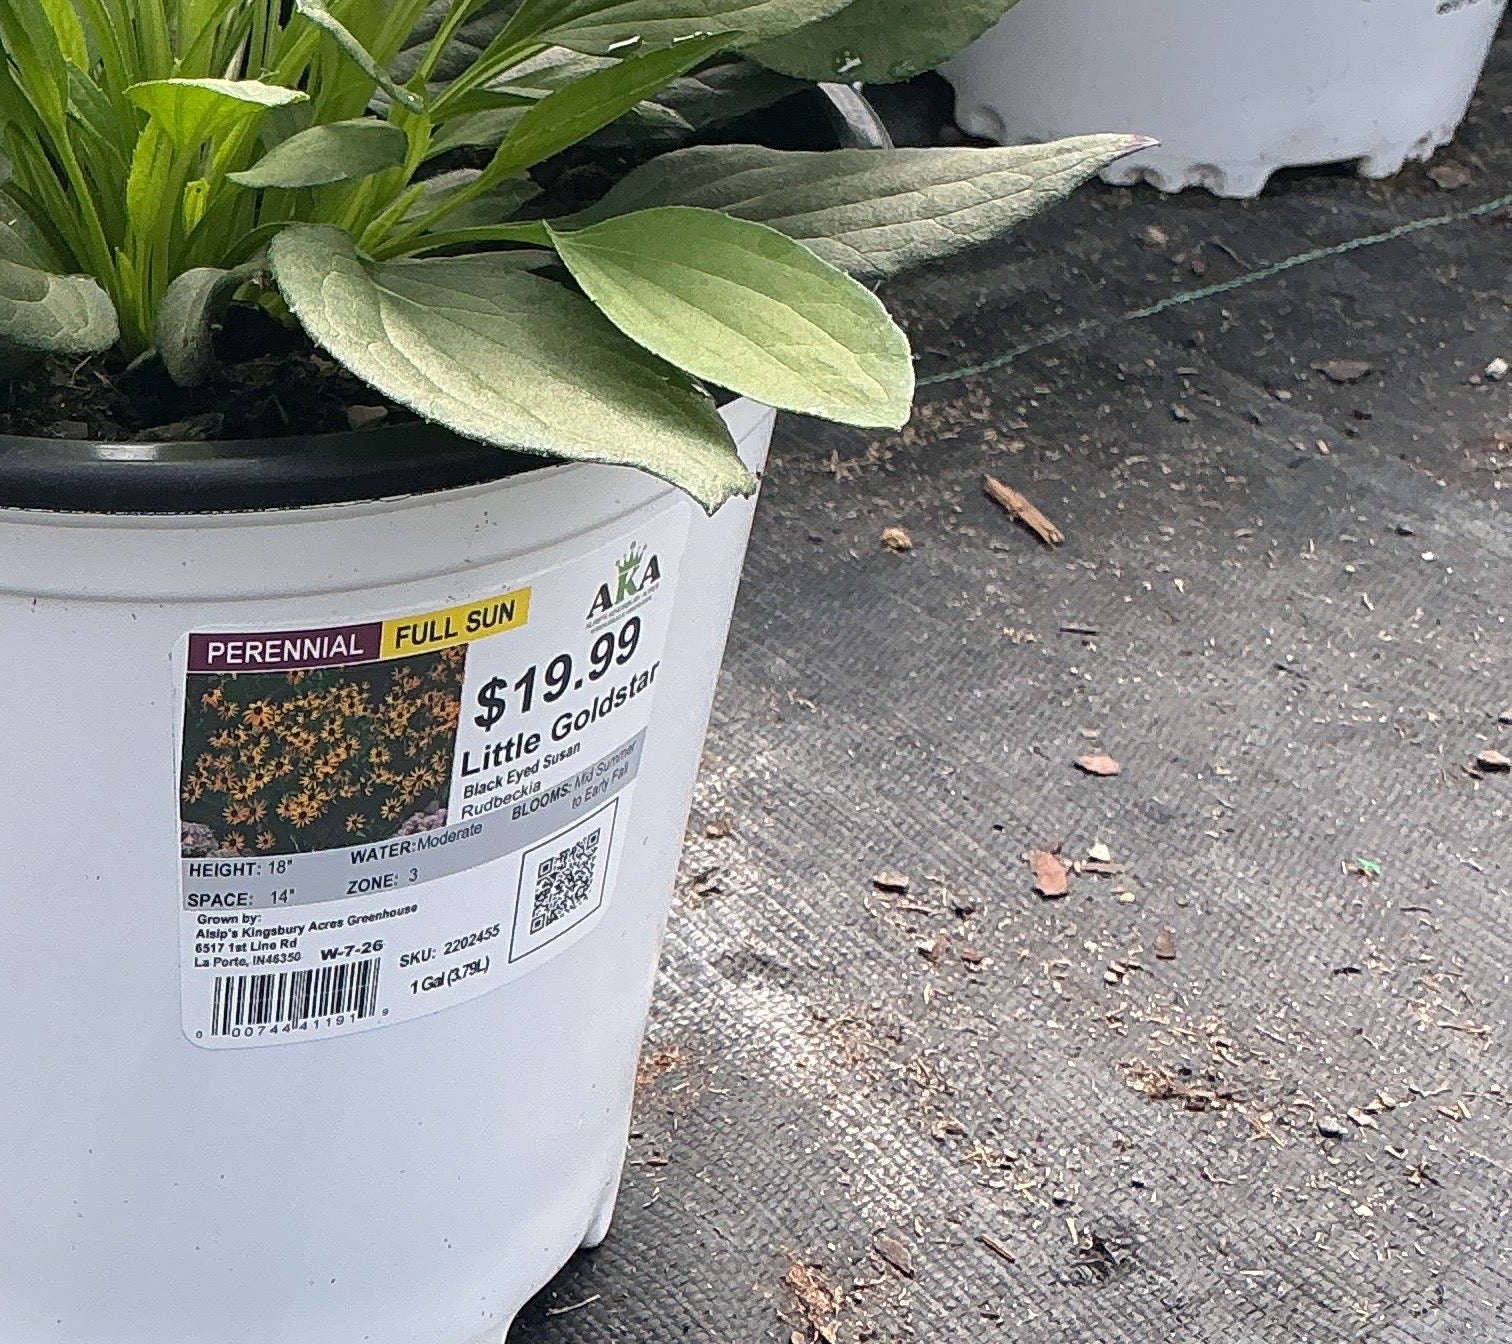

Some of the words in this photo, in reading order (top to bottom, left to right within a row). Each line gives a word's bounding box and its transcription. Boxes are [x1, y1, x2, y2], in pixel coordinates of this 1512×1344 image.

[586, 554, 662, 621] AKA
[206, 634, 364, 665] PERENNIAL
[395, 619, 459, 649] FULL
[465, 599, 516, 634] SUN
[474, 615, 642, 733] $19.99
[460, 732, 541, 778] Little
[551, 660, 661, 742] Goldstar
[463, 772, 503, 799] Black
[507, 759, 539, 784] Eyed
[543, 741, 581, 769] Susan
[461, 779, 542, 819] Rudbeckia
[511, 782, 572, 821] BLOOMS:
[572, 794, 583, 809] to
[189, 861, 262, 878] HEIGHT:
[268, 859, 294, 874] 18"
[346, 873, 400, 895] ZONE:
[408, 868, 419, 884] 3
[187, 891, 254, 908] SPACE:
[270, 889, 295, 905] 14"
[197, 914, 238, 925] Grown
[241, 912, 263, 926] by:
[241, 923, 305, 940] Kingsbury
[308, 918, 344, 933] Acres
[347, 903, 419, 927] Greenhouse
[195, 942, 225, 954] 6517
[228, 943, 249, 954] 1st
[250, 940, 278, 952] Line
[280, 938, 298, 949] Rd
[320, 939, 384, 961] W-7-26
[399, 946, 437, 968] SKU:
[443, 922, 501, 956] 2202455
[194, 957, 210, 968] La
[410, 979, 418, 994] 1
[421, 970, 445, 992] Gal
